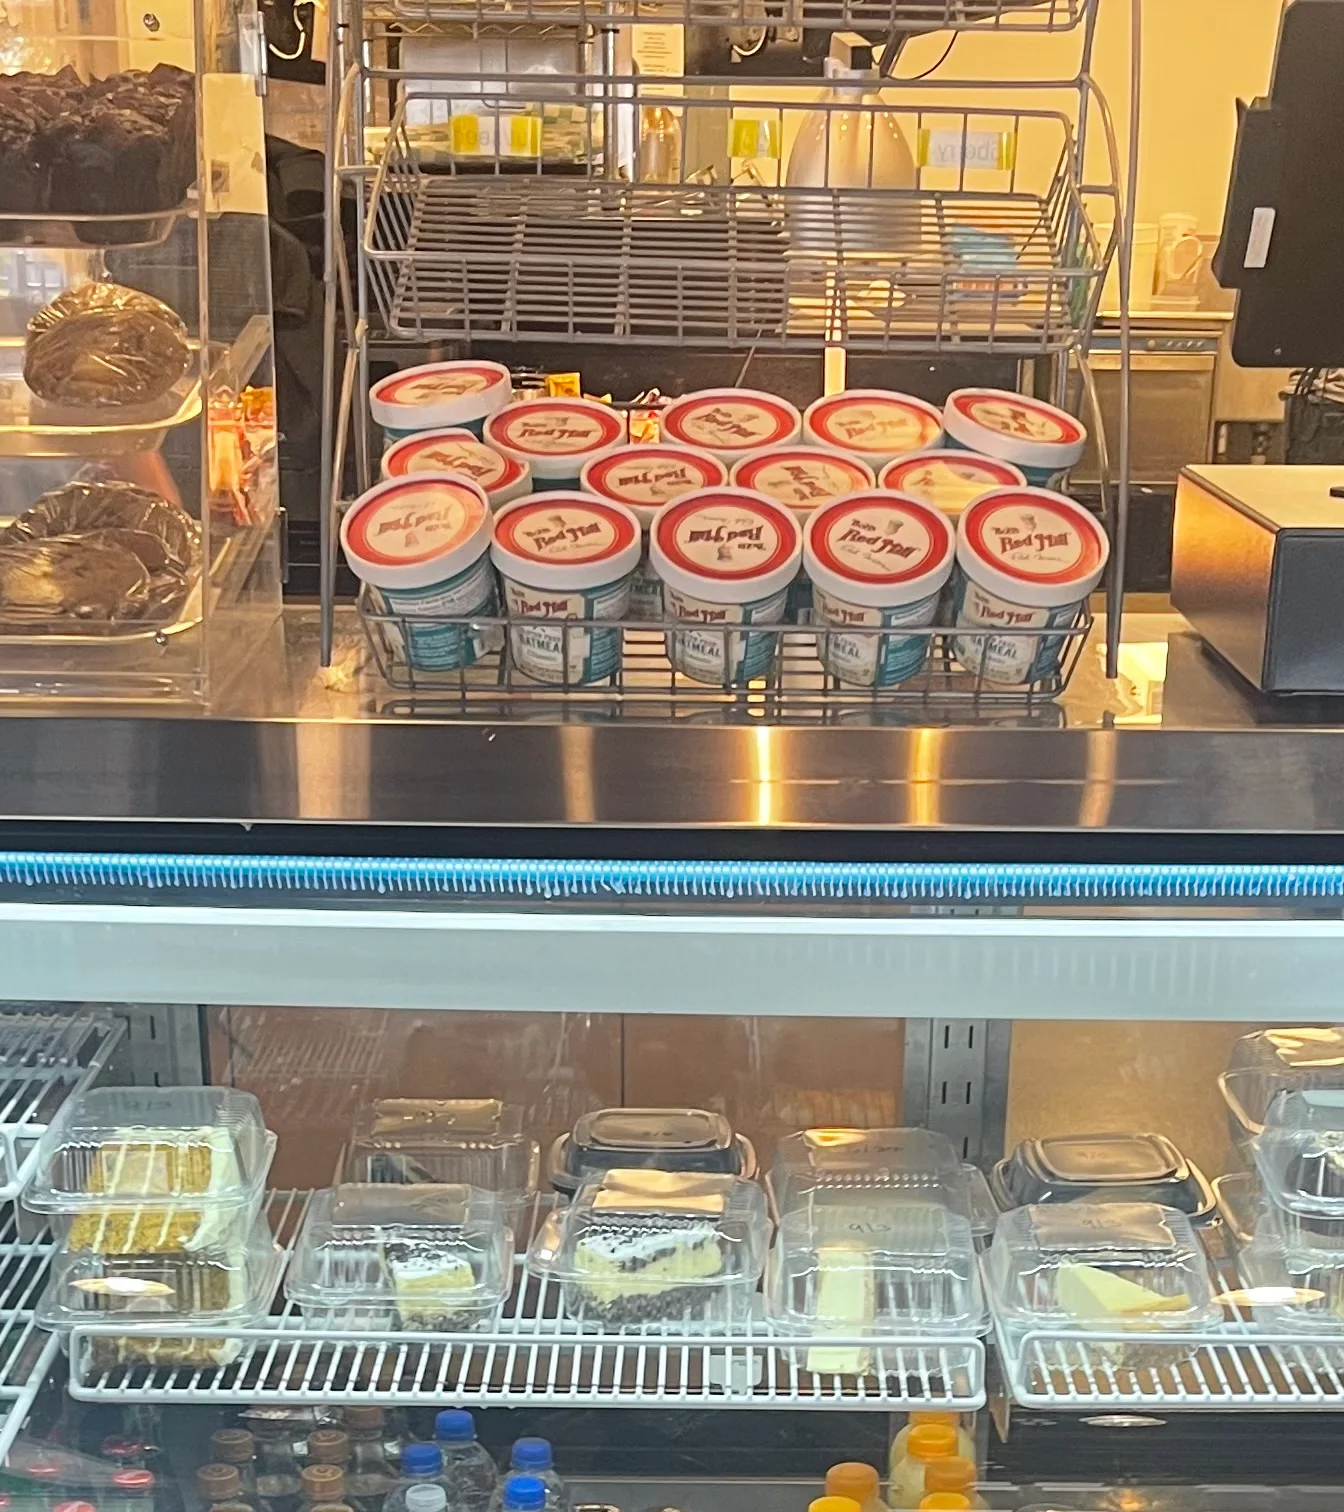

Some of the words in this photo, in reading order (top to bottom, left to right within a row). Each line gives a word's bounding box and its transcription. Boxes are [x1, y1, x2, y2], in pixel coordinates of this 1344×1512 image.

[532, 528, 565, 551] Red
[836, 528, 878, 546] Red
[875, 538, 921, 559] Mill
[1000, 534, 1034, 555] Red
[1034, 531, 1072, 552] Mill
[520, 600, 541, 614] Red
